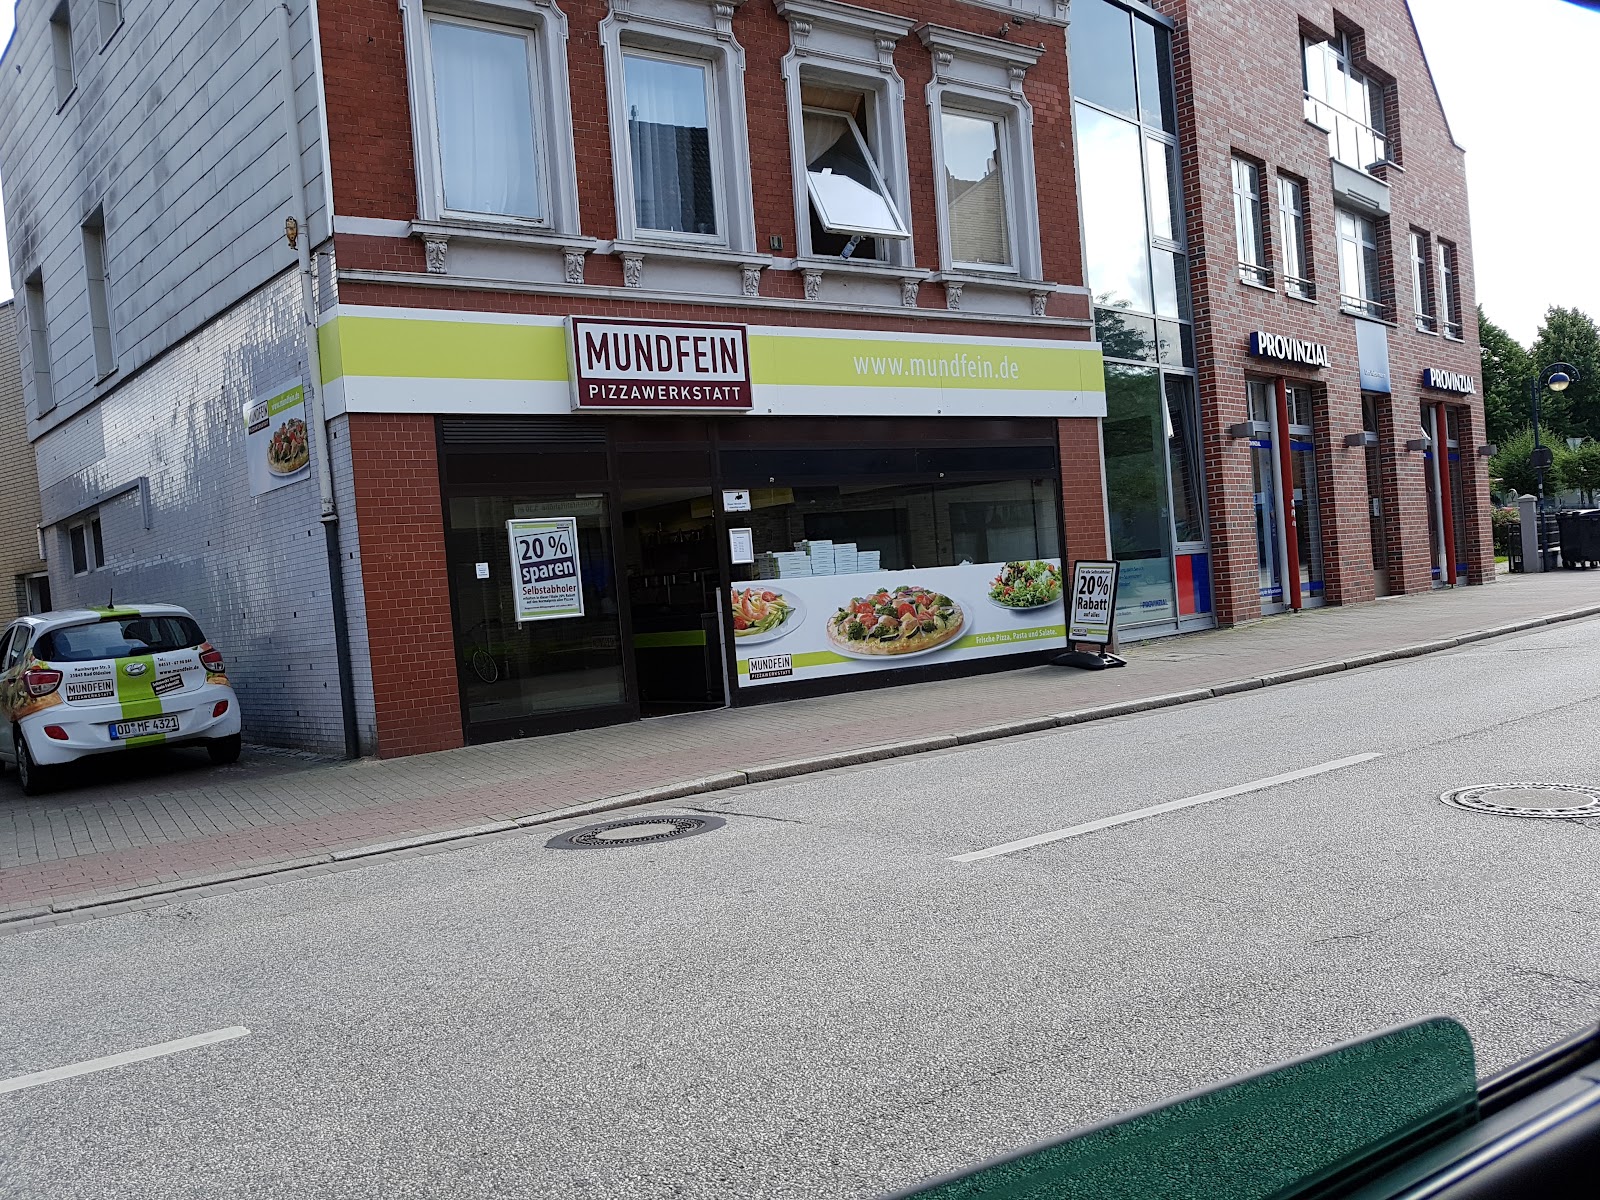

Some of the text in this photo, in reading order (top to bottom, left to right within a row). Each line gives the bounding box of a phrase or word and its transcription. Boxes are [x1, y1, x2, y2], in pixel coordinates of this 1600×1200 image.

[585, 331, 738, 374] MUNDFEIN
[1257, 331, 1331, 368] PROVINZIAL
[853, 353, 1019, 379] www.mundfein.de
[1430, 368, 1476, 394] PROVINZIAL
[589, 384, 741, 400] PIZZAWERKSTATT
[520, 534, 568, 561] 20 %
[522, 561, 574, 583] sparen
[522, 584, 577, 595] Selbstabholer
[1078, 575, 1109, 596] 20%
[1077, 597, 1107, 610] Rabatt
[976, 636, 995, 644] Frische
[751, 657, 790, 671] MUNDFEIN
[751, 669, 791, 679] PIZZAWERKSTATT
[68, 681, 111, 694] MUNDFEIN
[117, 717, 177, 735] OD MF 4321
